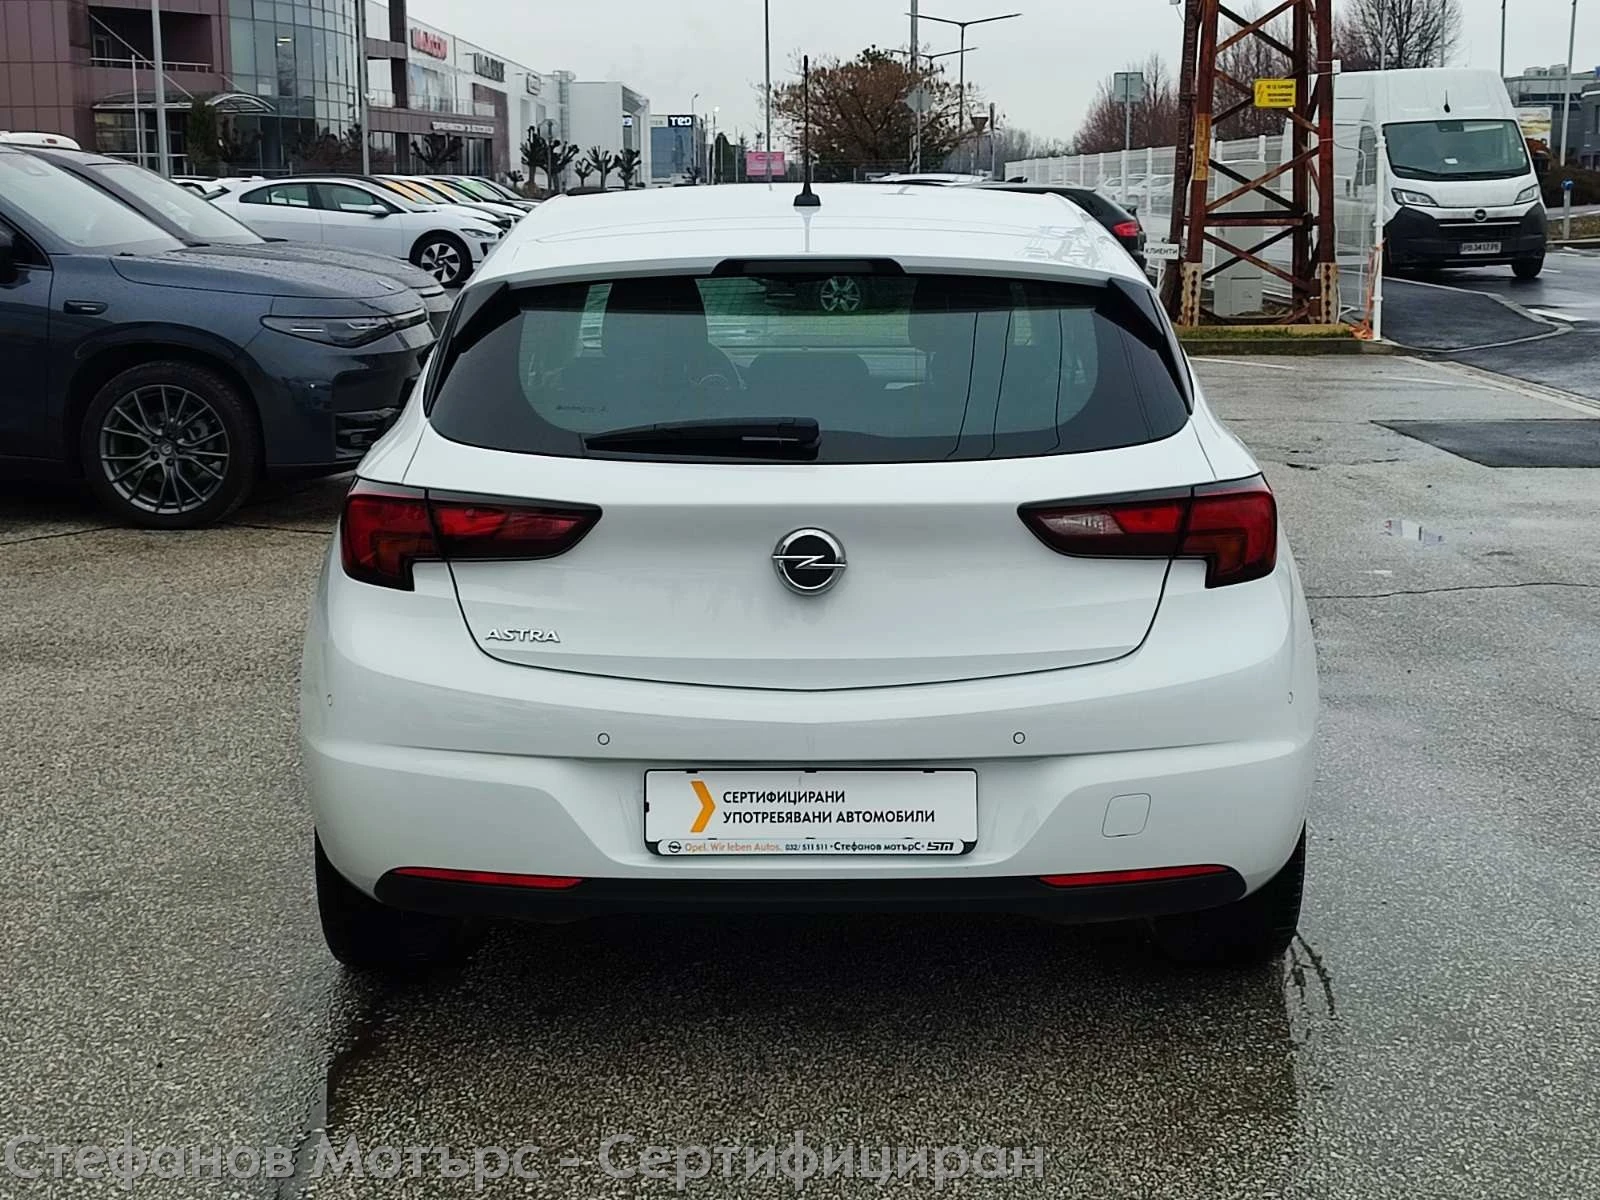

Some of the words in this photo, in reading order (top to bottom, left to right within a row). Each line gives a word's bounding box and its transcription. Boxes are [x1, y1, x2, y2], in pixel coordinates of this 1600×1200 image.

[486, 628, 561, 643] ASTRA
[723, 790, 845, 805] СЕРТИФИЦИРАНИ
[723, 811, 832, 824] УПОТРЕБЯВАНИ
[836, 810, 936, 823] АВТОМОБИЛИ
[727, 841, 752, 851] leben
